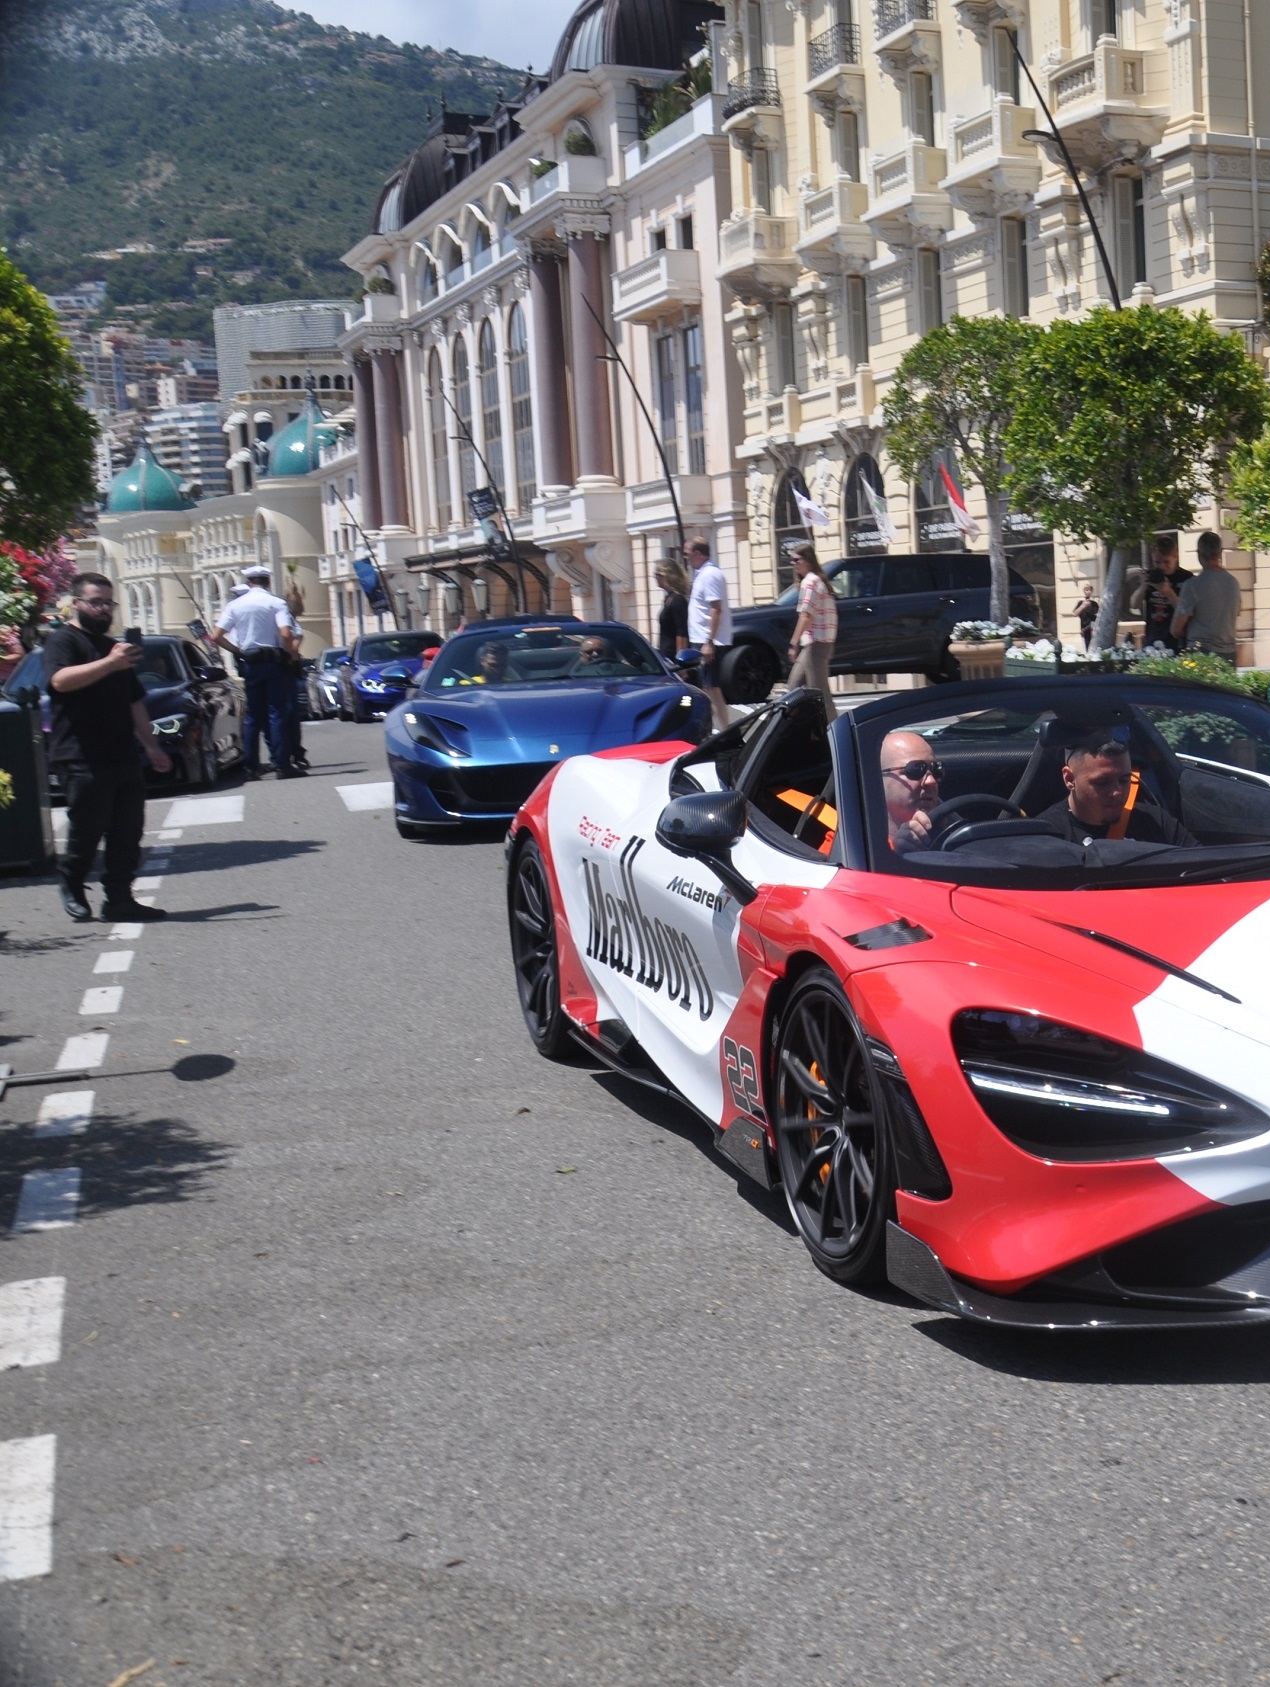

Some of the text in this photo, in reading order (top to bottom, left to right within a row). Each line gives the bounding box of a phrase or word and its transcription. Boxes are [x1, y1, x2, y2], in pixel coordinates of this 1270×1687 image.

[581, 834, 715, 1022] Marlboro
[666, 875, 723, 913] McLaren
[723, 1035, 769, 1127] 22
